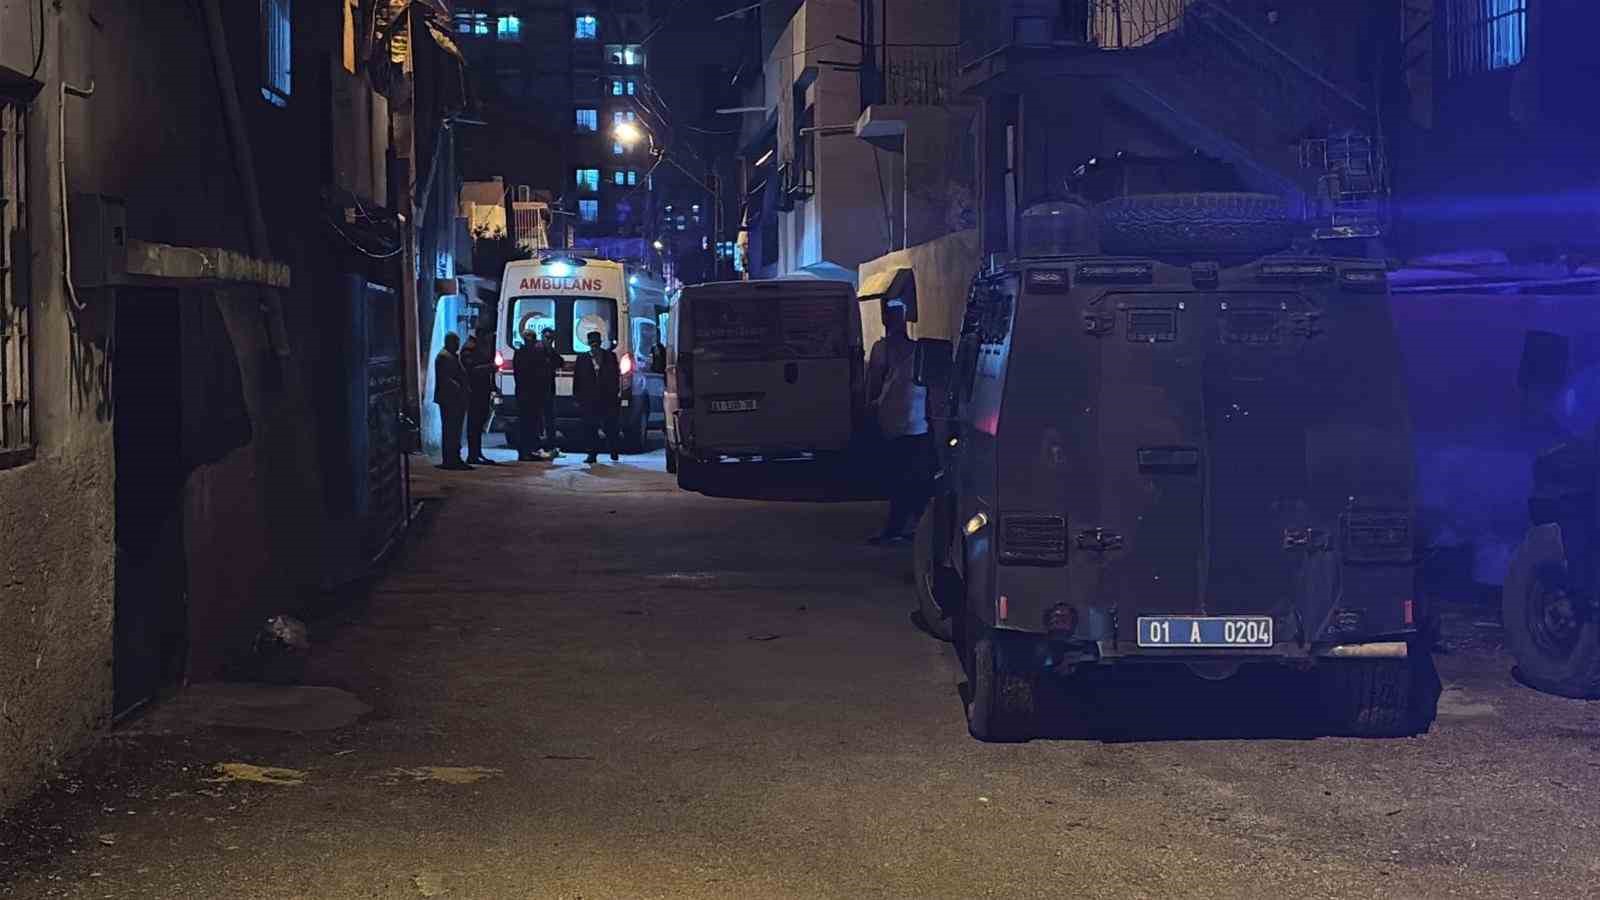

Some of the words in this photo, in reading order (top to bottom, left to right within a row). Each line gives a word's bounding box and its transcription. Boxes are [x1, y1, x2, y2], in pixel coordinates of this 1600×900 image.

[519, 278, 602, 291] AMBULANS
[1150, 621, 1169, 642] 01
[1190, 621, 1201, 642] A
[1224, 621, 1269, 642] 0204
